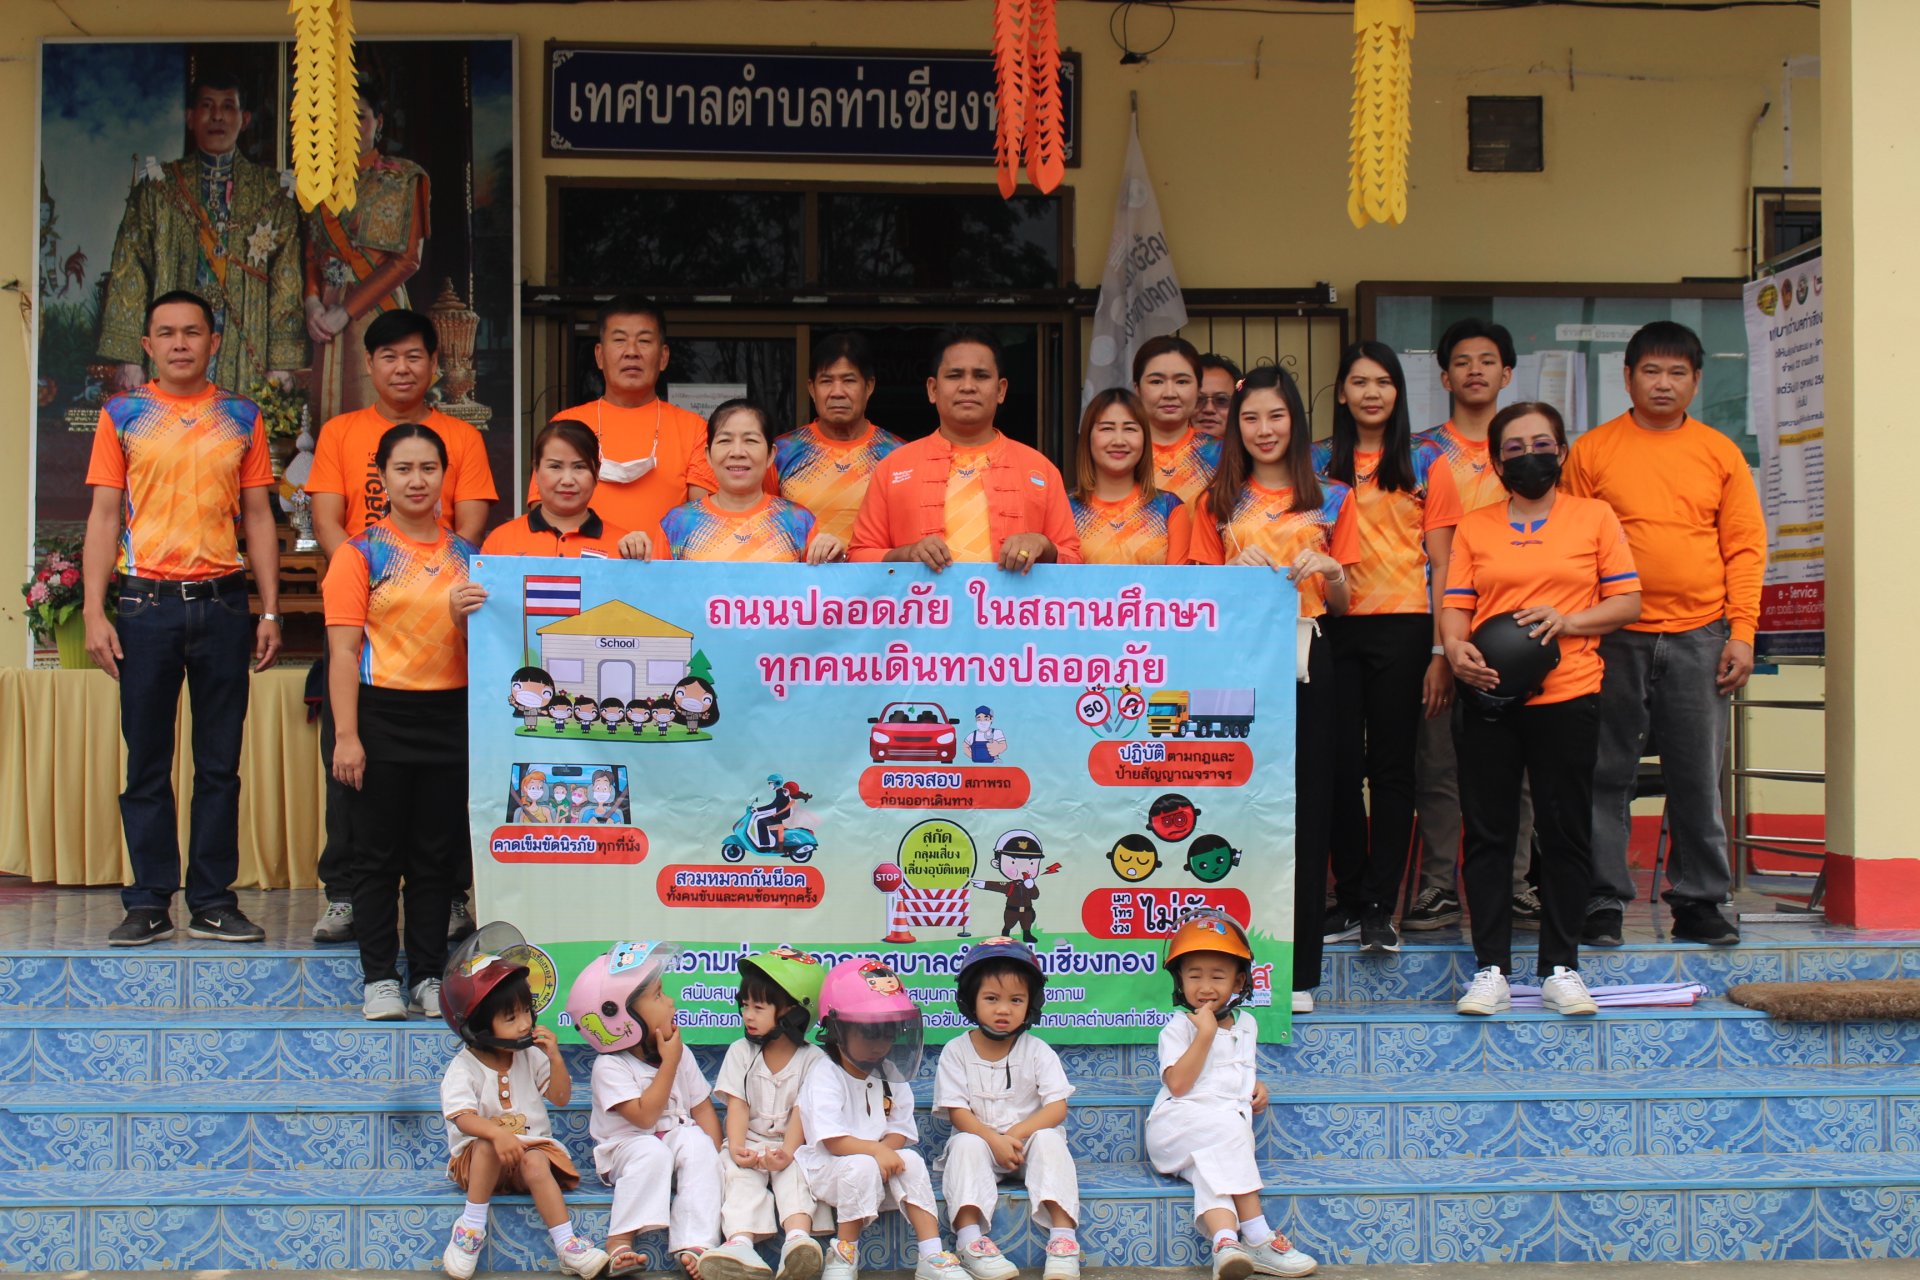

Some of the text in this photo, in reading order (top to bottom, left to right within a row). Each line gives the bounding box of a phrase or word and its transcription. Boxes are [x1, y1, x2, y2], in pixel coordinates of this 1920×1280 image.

[708, 581, 1217, 629] ถนนปลอดภัย ในสถานศึกษา
[600, 638, 635, 648] School
[760, 643, 1165, 697] ทุกคนเดินทางปลอดภัย
[1083, 700, 1104, 718] 50
[883, 772, 1011, 789] ตรวจสอบ สภาพรถ
[1115, 765, 1232, 782] ป้ายสัญญาณจราจร
[880, 791, 974, 806] ก่อนออกเดินทาง
[922, 828, 952, 844] สกัด
[494, 835, 640, 855] คาดเข็มขัดนิรภัย ทุกที่นั่ง
[914, 845, 960, 862] กลุ่มเสี่ยง
[904, 860, 970, 878] เลี่ยงอุบัติเหตุ
[676, 869, 806, 887] สวมหมวกกันน็อค
[666, 886, 818, 906] ทั้งคนขับและคนซ้อนทุกครั้ง
[1113, 893, 1131, 903] เมา
[1112, 906, 1133, 918] โทร
[1112, 921, 1130, 933] ง่วง
